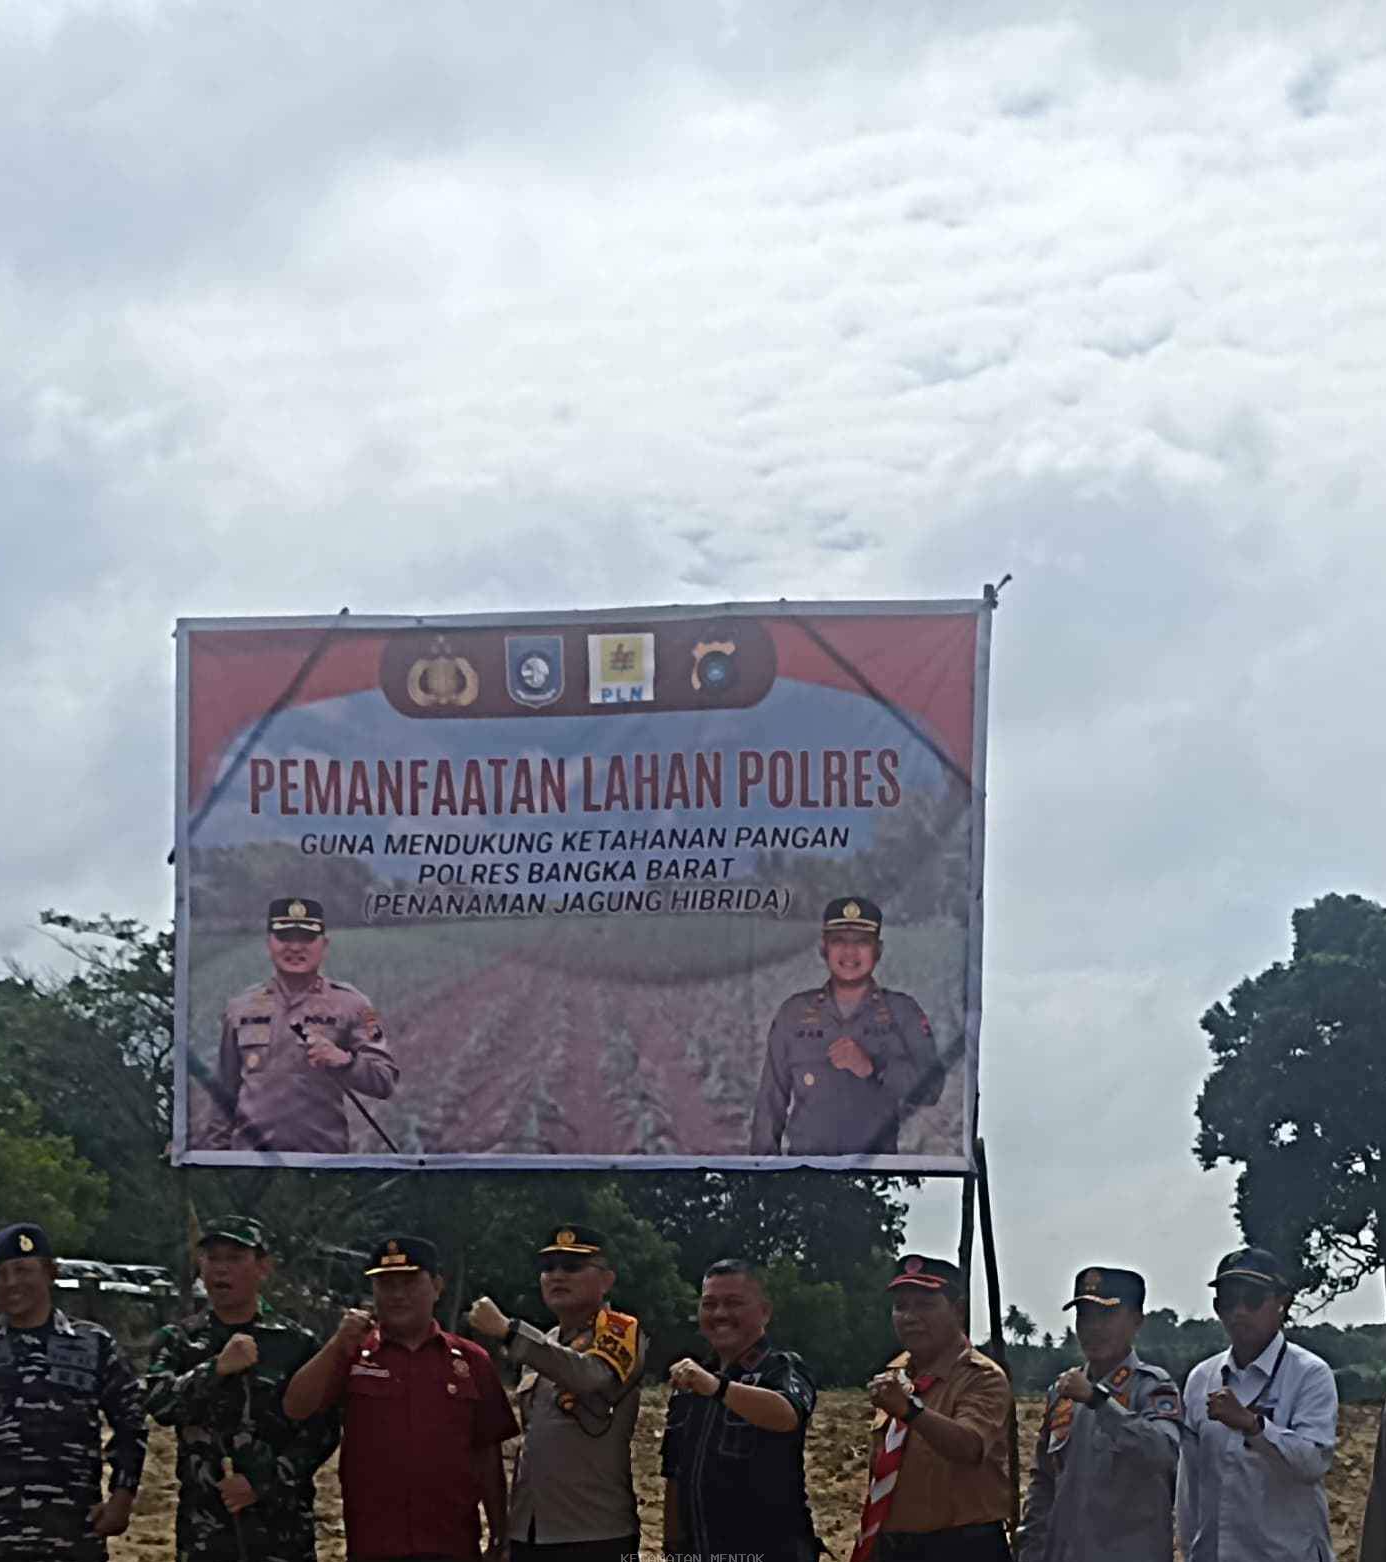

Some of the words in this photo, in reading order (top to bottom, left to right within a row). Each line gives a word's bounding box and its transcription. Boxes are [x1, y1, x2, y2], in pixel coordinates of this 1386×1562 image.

[601, 687, 644, 701] PLN
[249, 757, 567, 817] PEMANFAATAN
[581, 751, 723, 813] LAHAN
[738, 747, 902, 809] POLRES
[300, 832, 375, 856] GUNA
[383, 831, 554, 856] MENDUKUNG
[560, 828, 727, 853] KETAHANAN
[733, 825, 851, 850] PANGAN
[417, 862, 520, 886] POLRES
[527, 859, 637, 884] BANGKA
[645, 857, 736, 882] BARAT
[363, 892, 547, 919] (PENANAMAN
[553, 889, 663, 914] JAGUNG
[669, 887, 791, 914] HIBRIDA)
